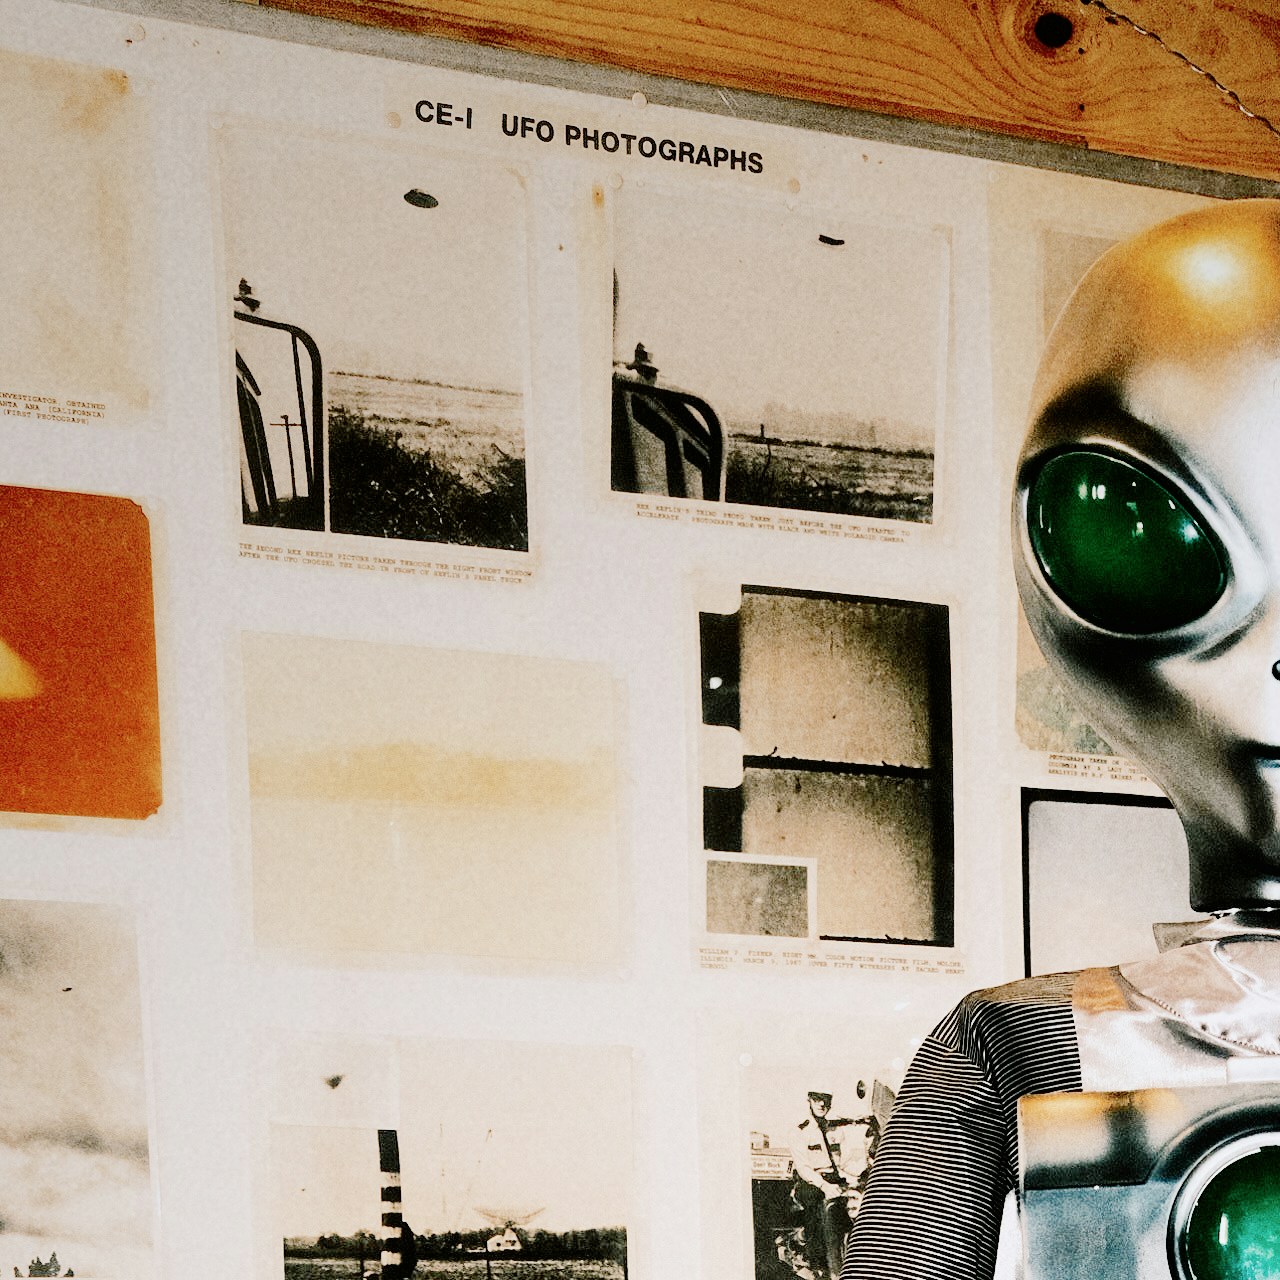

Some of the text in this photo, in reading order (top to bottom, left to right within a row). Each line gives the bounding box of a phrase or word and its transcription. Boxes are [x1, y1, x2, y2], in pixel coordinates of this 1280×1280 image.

[415, 100, 764, 174] CE-I UFO PHOTOGRAPHS
[25, 403, 40, 411] ANA
[48, 406, 105, 419] (CALIFORNIA)
[66, 400, 105, 410] OBTAINED
[3, 408, 31, 418] (FIRST
